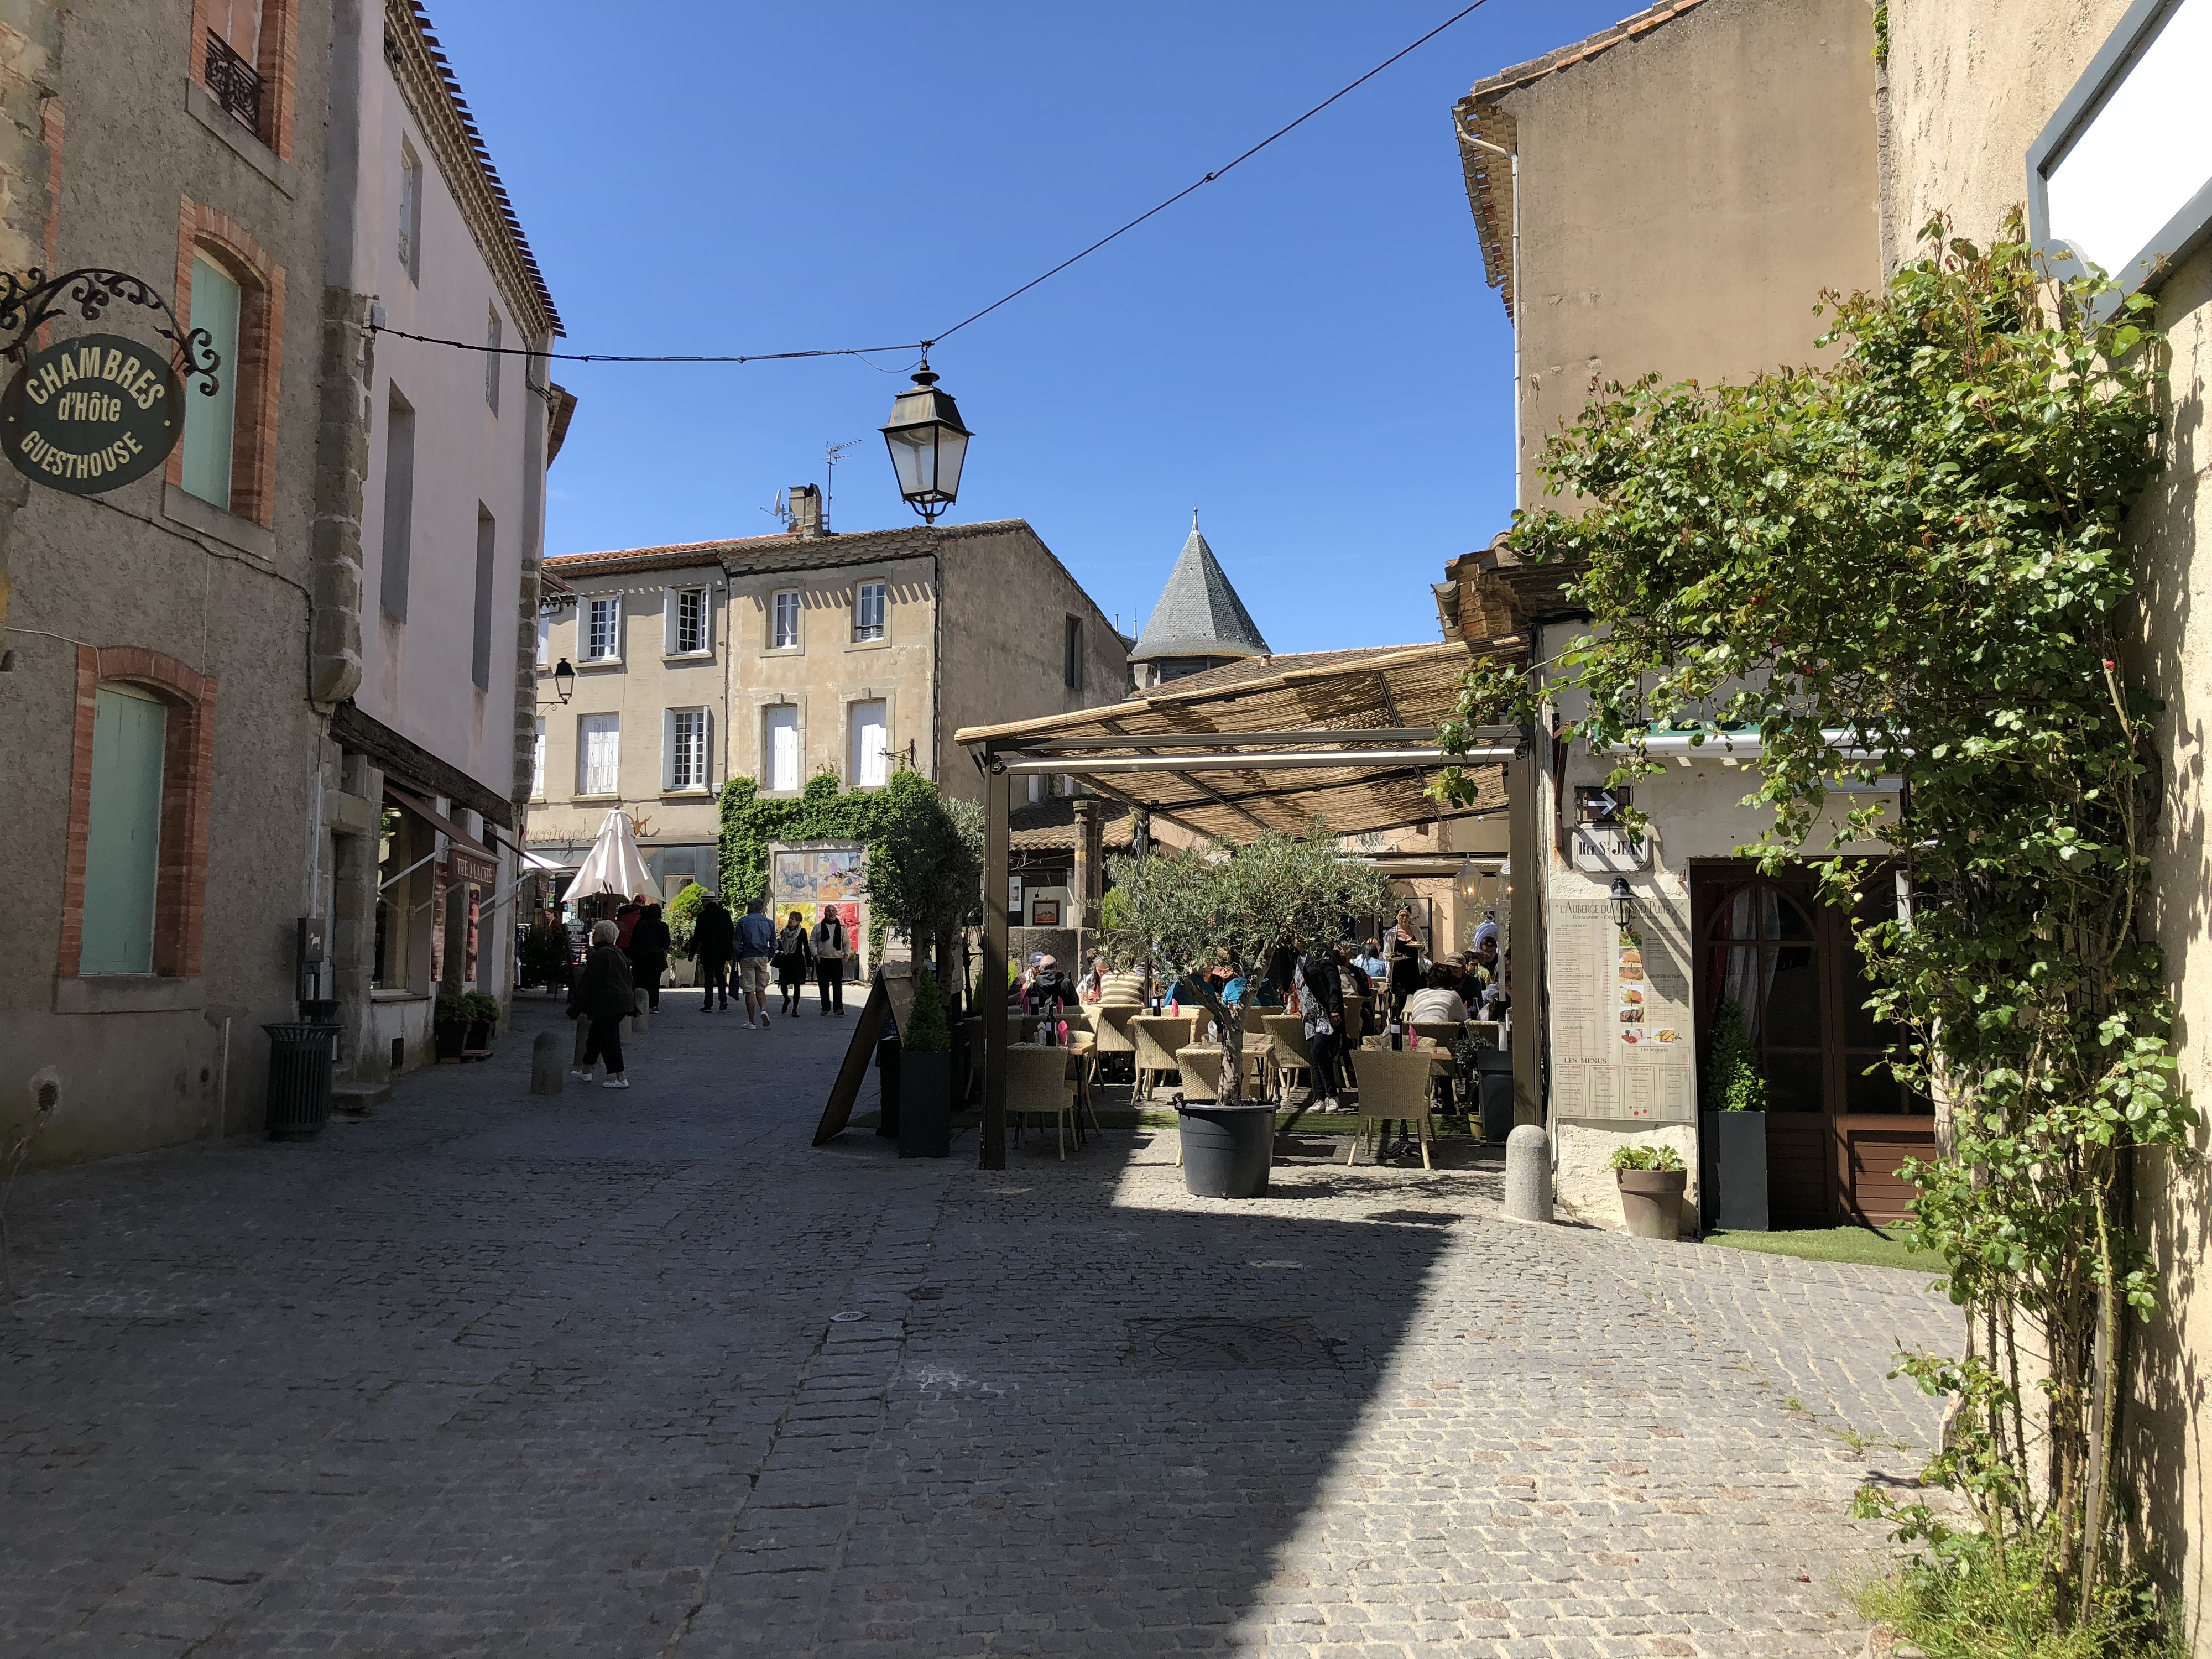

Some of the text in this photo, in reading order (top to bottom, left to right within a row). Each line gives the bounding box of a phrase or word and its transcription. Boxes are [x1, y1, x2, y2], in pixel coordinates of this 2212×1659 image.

[26, 347, 165, 409] CHAMBRES
[58, 392, 121, 422] d'Hôte
[20, 431, 143, 479] GUESTHOUSE
[1611, 841, 1643, 855] JEAN
